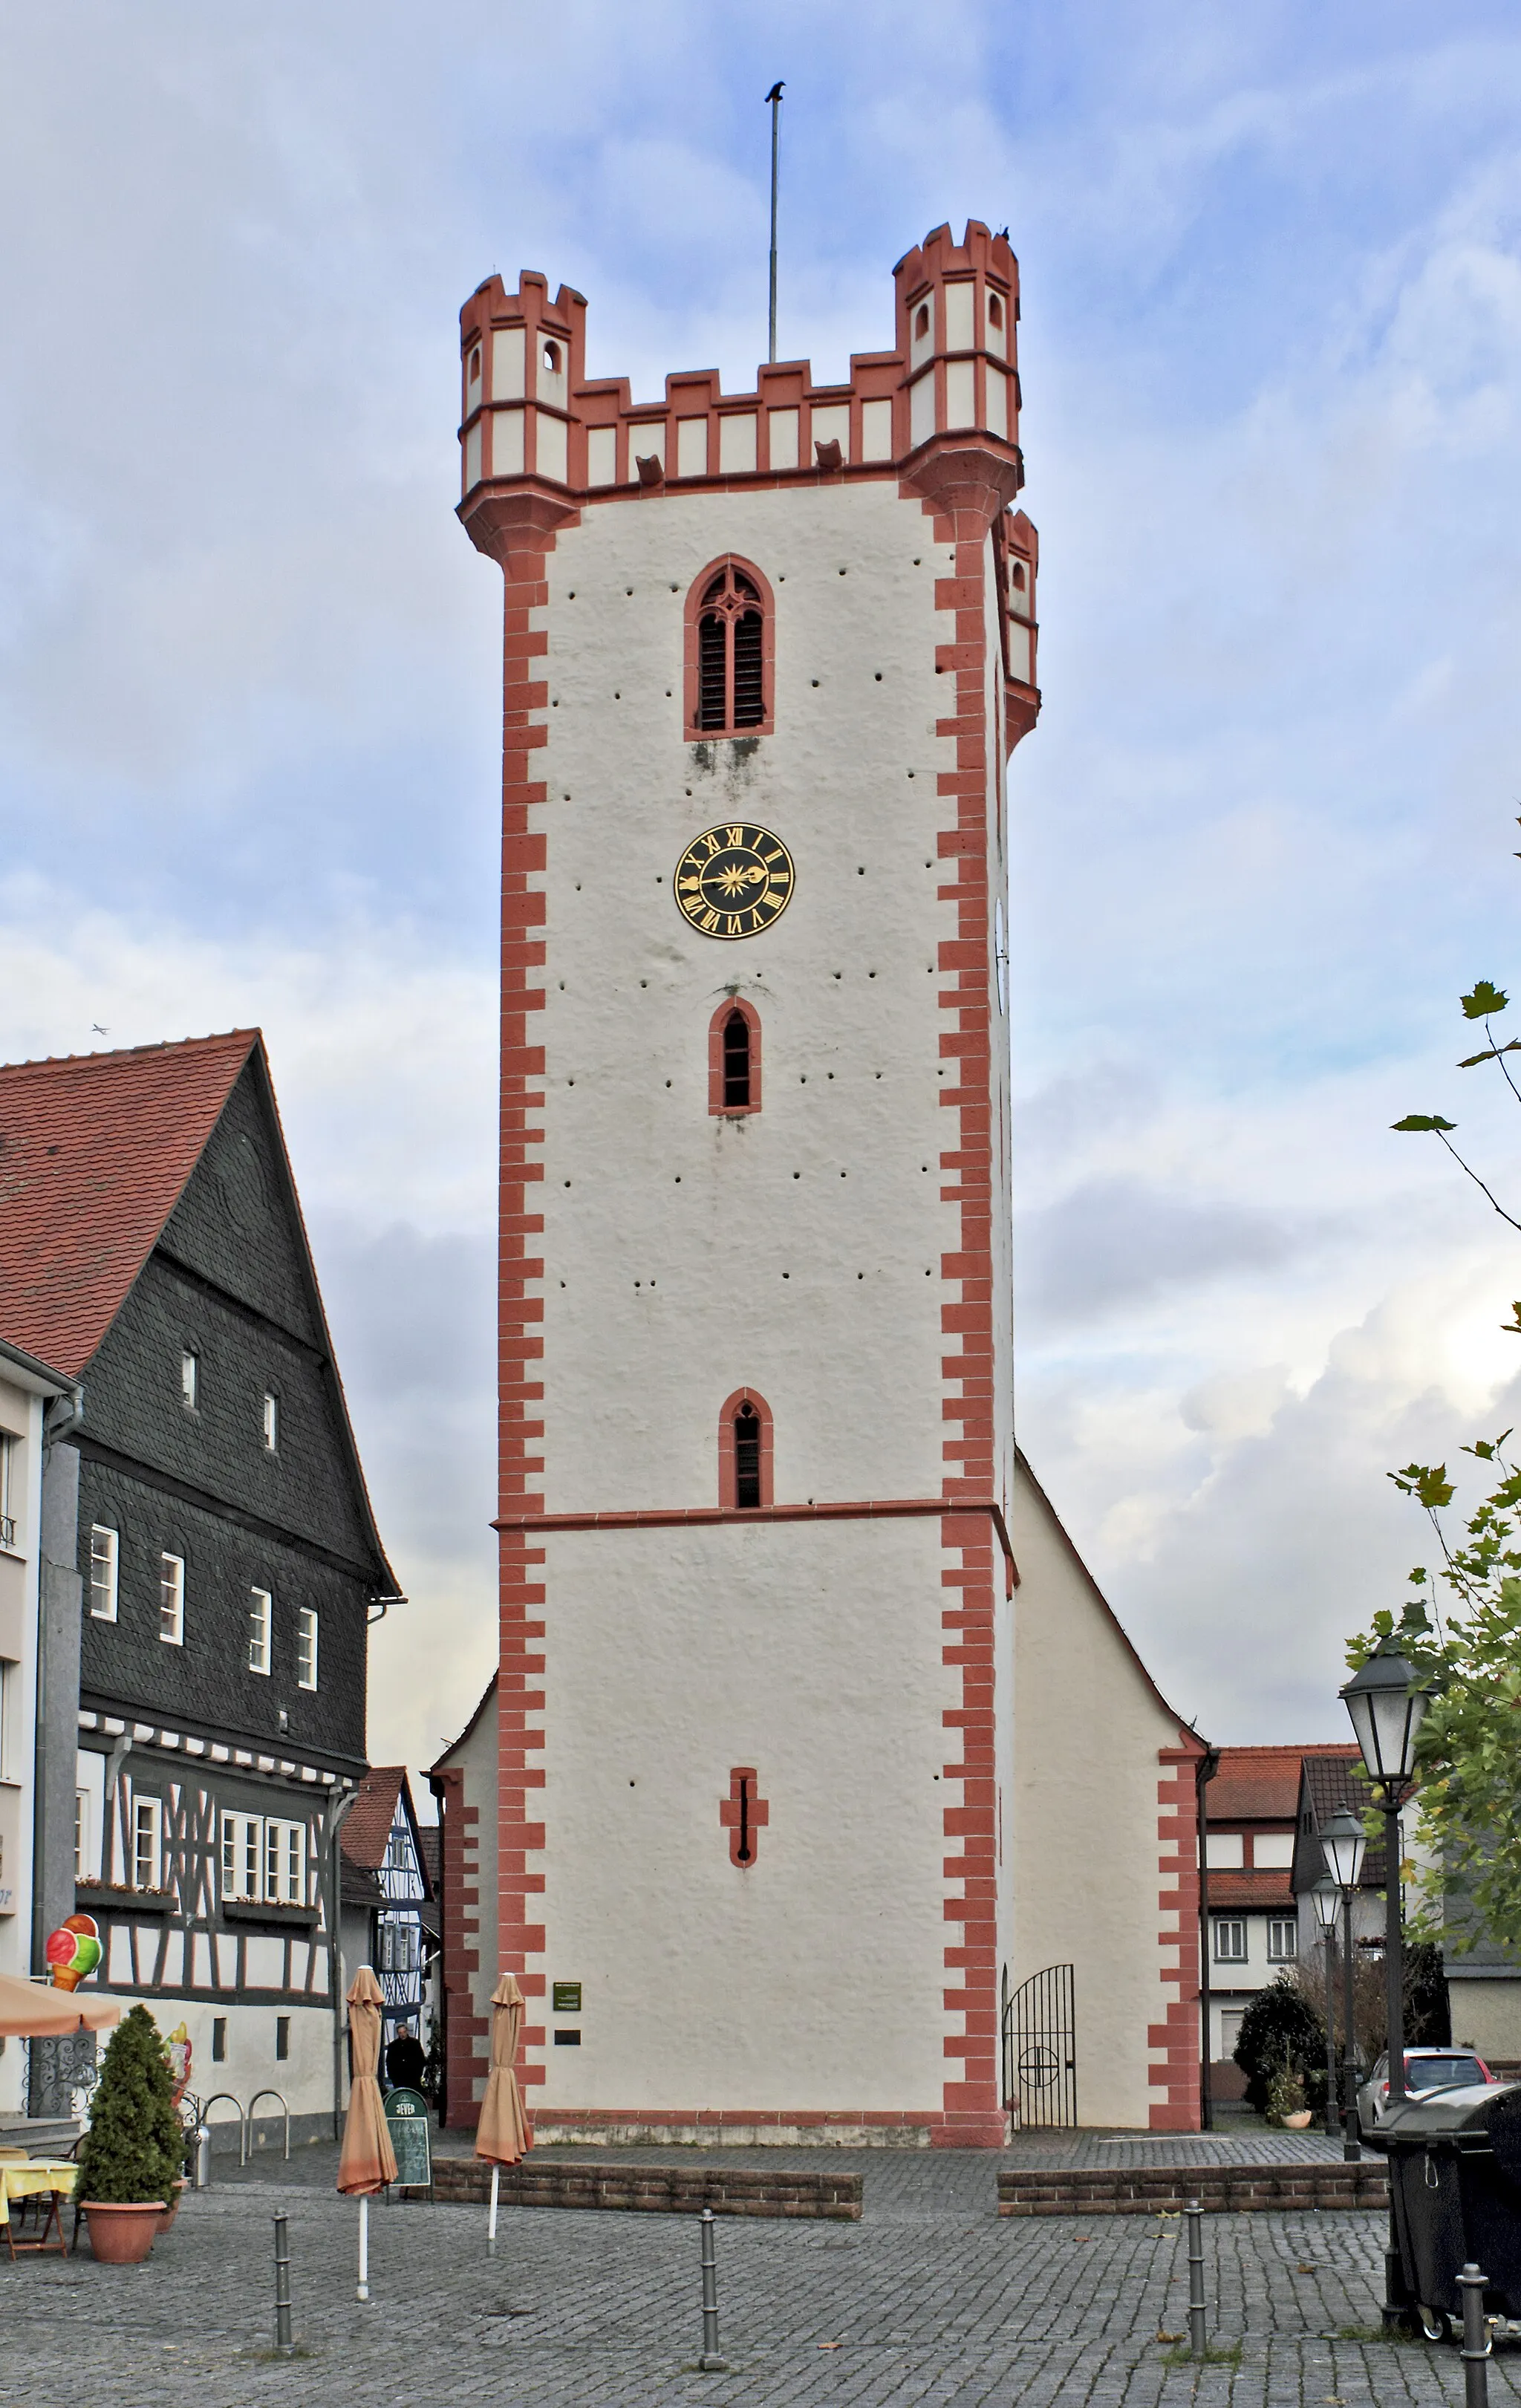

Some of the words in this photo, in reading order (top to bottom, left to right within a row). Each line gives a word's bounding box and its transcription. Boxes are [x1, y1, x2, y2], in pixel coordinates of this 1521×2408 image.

[701, 834, 720, 854] XI
[726, 827, 743, 847] XII
[752, 833, 763, 850] I
[685, 853, 705, 869] X
[764, 849, 783, 863] II
[770, 872, 789, 883] III
[728, 915, 742, 934] VI
[752, 908, 763, 928] V
[396, 2103, 415, 2115] JEVER
